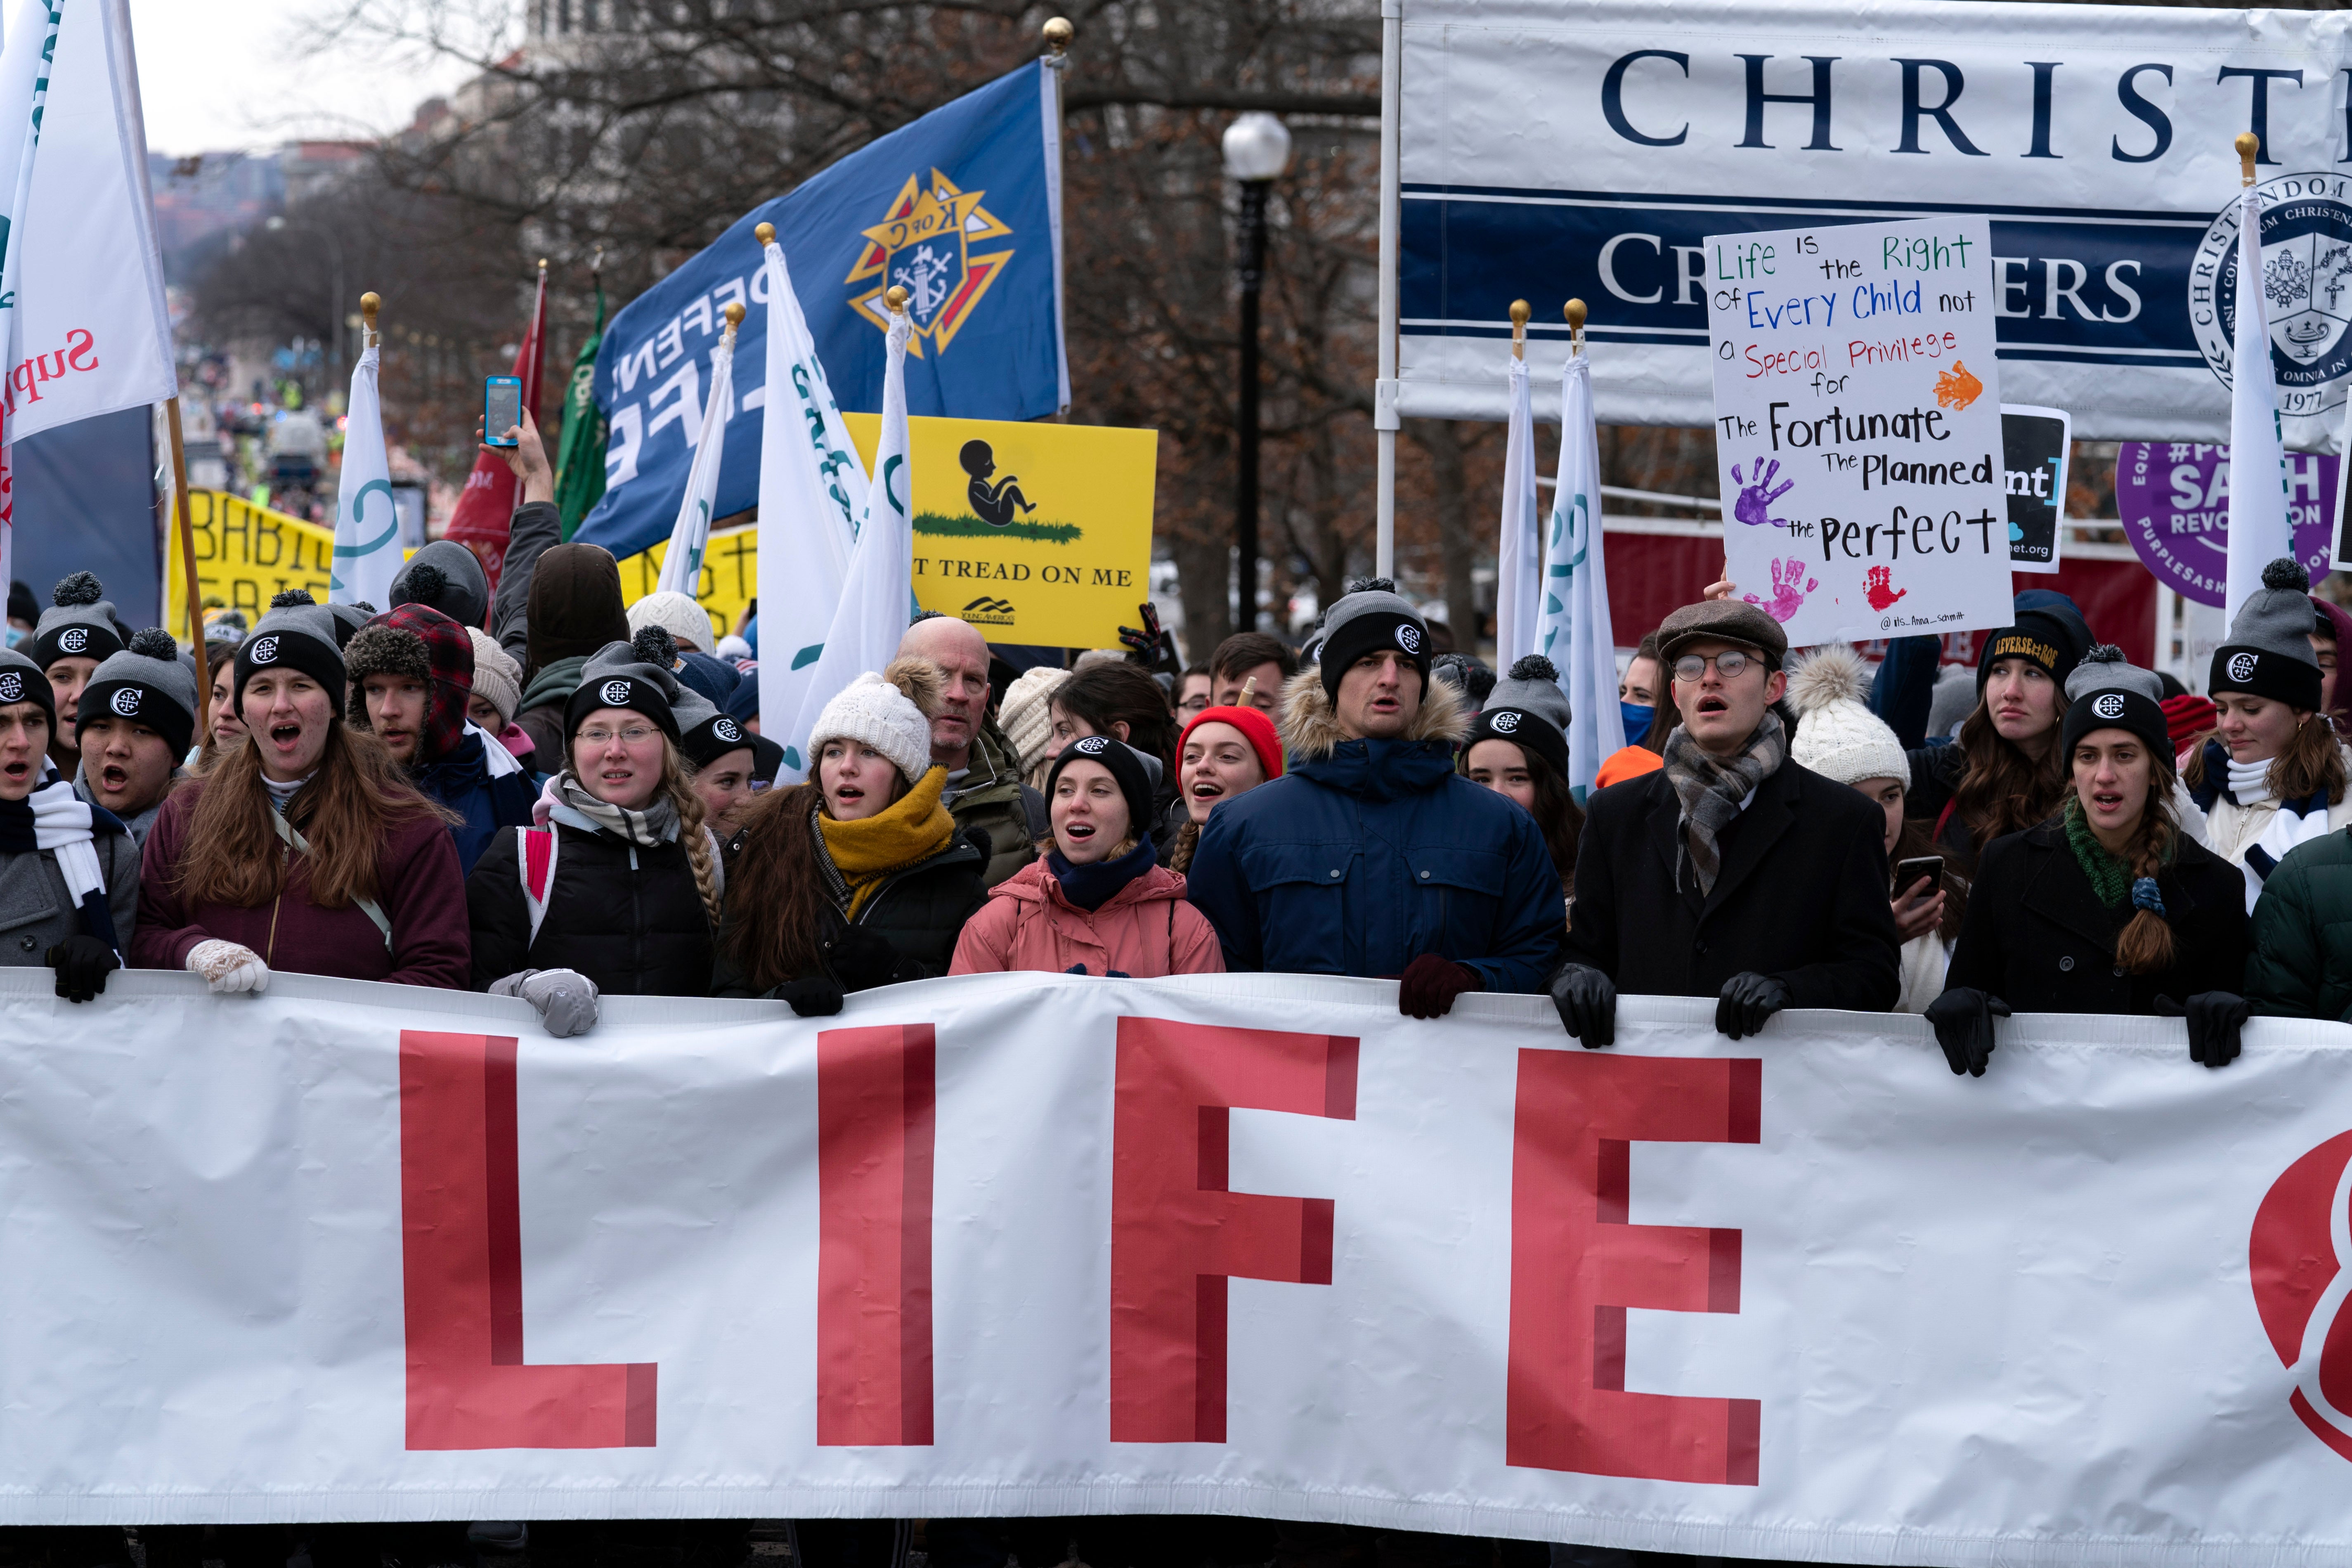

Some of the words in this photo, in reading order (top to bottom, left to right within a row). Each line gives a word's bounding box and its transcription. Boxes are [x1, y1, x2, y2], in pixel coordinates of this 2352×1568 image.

[1718, 243, 1775, 280] Life
[1820, 259, 1863, 279] the
[1883, 234, 1973, 272] Right
[2194, 178, 2346, 326] CHRISTNDOM
[1598, 232, 2142, 323] CRERS
[1747, 291, 1836, 329] Every
[1853, 279, 1922, 319] Child
[1939, 290, 1976, 312] not
[1719, 340, 1735, 360] a
[1744, 344, 1827, 378] Special
[1848, 331, 1957, 368] Privilege
[1810, 372, 1849, 397] for
[2283, 391, 2322, 411] 1977
[1718, 415, 1758, 440] The
[1769, 402, 1951, 451] Fortunate
[1820, 452, 1858, 472] The
[1863, 454, 1993, 491] Planned
[2170, 455, 2320, 510] SAH
[1787, 520, 1815, 538] the
[939, 559, 1031, 581] TREAD
[1042, 565, 1082, 584] ON
[1092, 569, 1132, 587] ME
[1995, 636, 2033, 655] REVERSE
[2040, 644, 2058, 669] ROE
[399, 1016, 1762, 1486] LIFE
